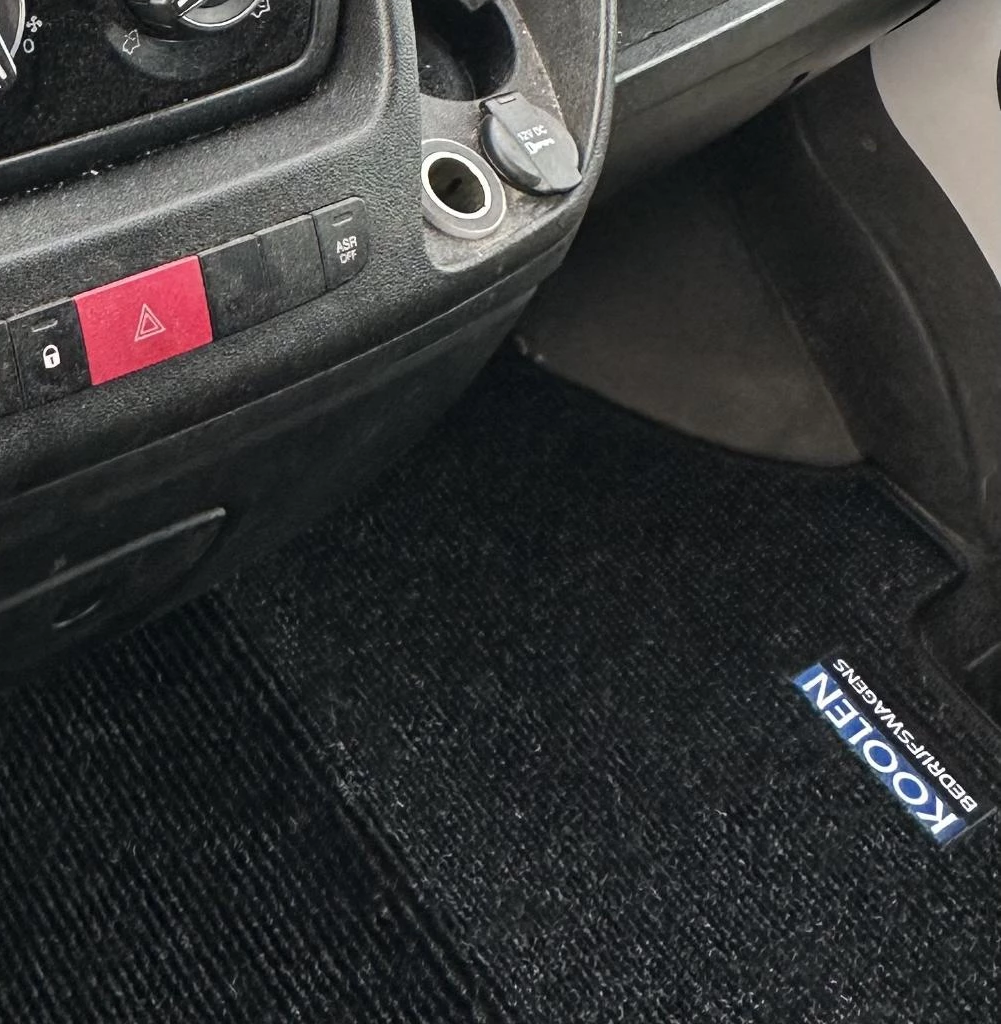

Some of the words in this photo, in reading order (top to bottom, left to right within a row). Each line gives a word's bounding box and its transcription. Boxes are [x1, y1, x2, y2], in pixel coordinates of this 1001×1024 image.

[517, 128, 533, 142] 12V
[532, 124, 548, 136] DC
[336, 235, 357, 254] ASR
[339, 248, 357, 264] OFF
[832, 658, 978, 813] BEDRIJFSWAGENS
[802, 672, 958, 835] KOOLEN
